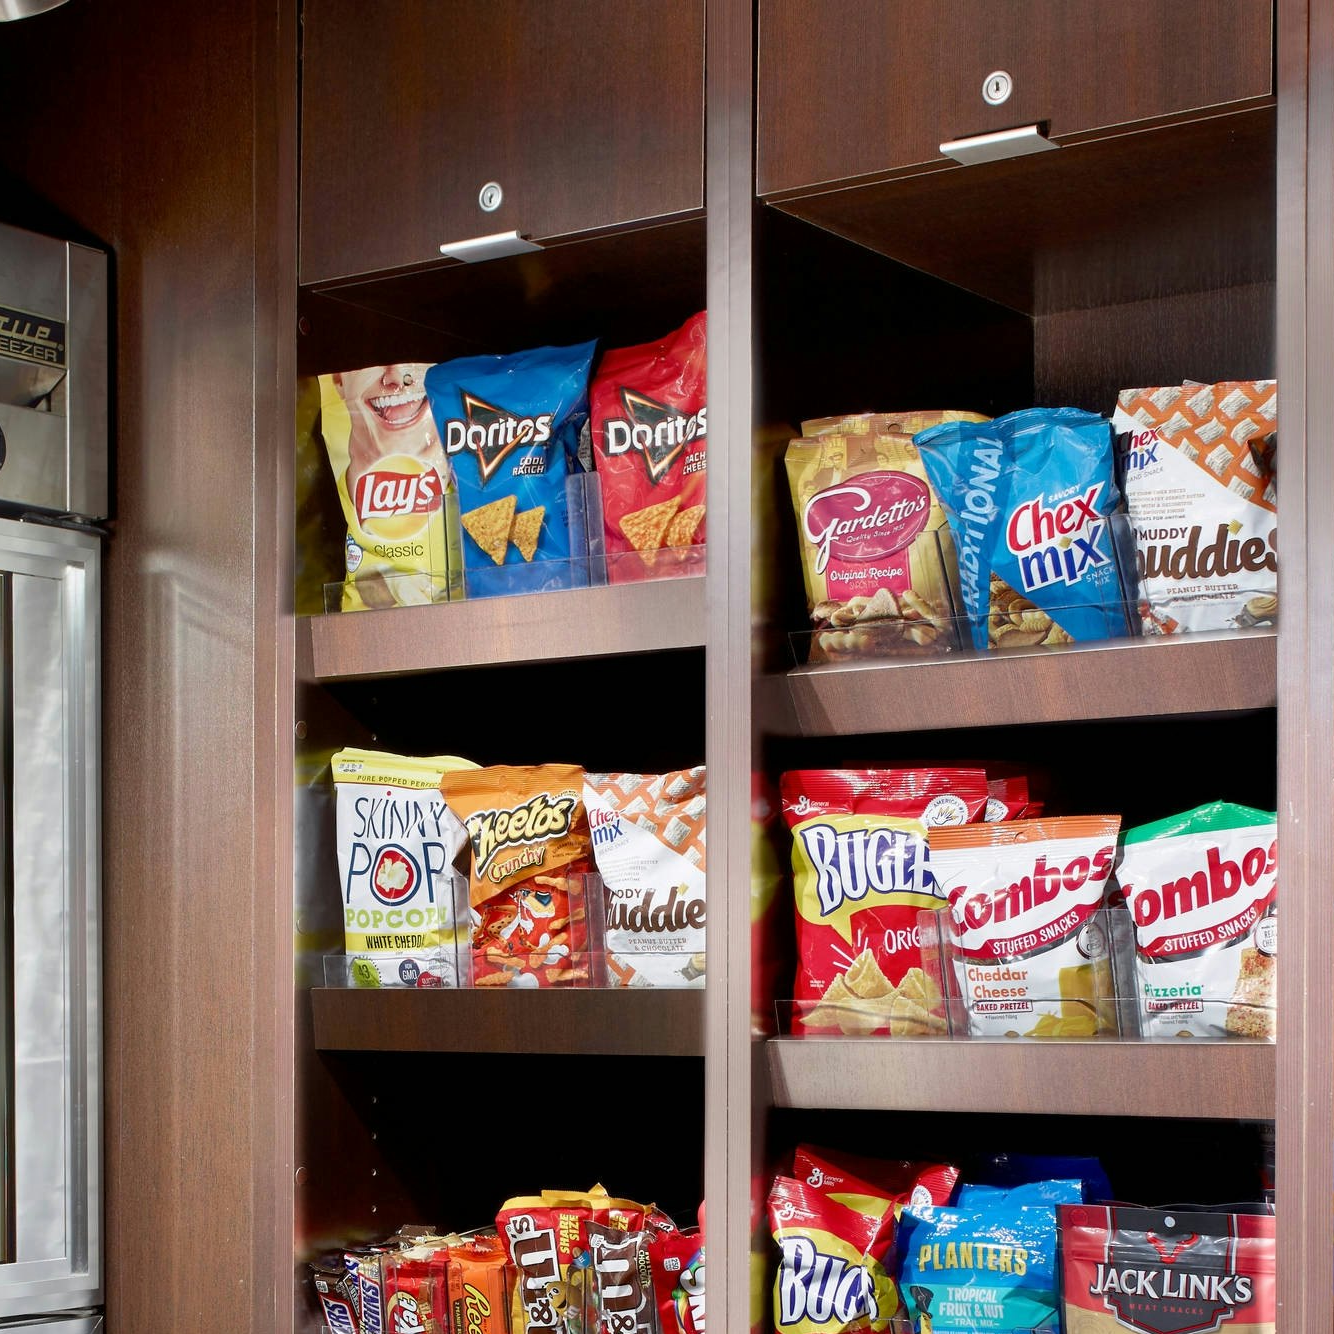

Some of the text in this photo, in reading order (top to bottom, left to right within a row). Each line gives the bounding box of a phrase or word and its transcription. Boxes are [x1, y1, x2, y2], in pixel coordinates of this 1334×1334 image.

[446, 413, 553, 454] Doritos
[520, 456, 544, 466] COOL
[513, 465, 544, 475] RANCH
[361, 474, 436, 520] Lay's
[1008, 487, 1099, 551] Chex
[805, 487, 925, 575] Gardetto's
[847, 534, 871, 543] Quality
[1140, 527, 1188, 541] MUDDY
[374, 543, 424, 558] Classic
[1022, 524, 1105, 589] mix
[831, 566, 903, 583] Original Recipe
[1086, 567, 1115, 582] SNACK
[1167, 585, 1202, 594] PEANUT
[379, 777, 407, 785] POPPED
[593, 819, 623, 845] mix
[488, 846, 546, 882] Crunchy
[347, 842, 445, 906] POP
[993, 911, 1080, 956] STUFFED SNACKS
[1164, 907, 1257, 952] STUFFED SNACKS
[366, 935, 392, 949] WHITE
[402, 968, 417, 980] GMO
[968, 967, 1028, 982] Cheddar
[976, 1001, 1029, 1012] BAKED PRETZEL
[1148, 1001, 1200, 1011] BAKED PRETZEL
[559, 1214, 570, 1254] SHARE
[569, 1215, 579, 1241] SIZE
[919, 1242, 1028, 1276] PLANTERS
[1090, 1264, 1253, 1305] JACK LINK'S
[947, 1287, 997, 1303] TROPICAL
[939, 1303, 1004, 1318] FRUIT & NUT
[1129, 1303, 1204, 1315] MEAT SNACKS
[954, 1318, 978, 1326] TRAIL
